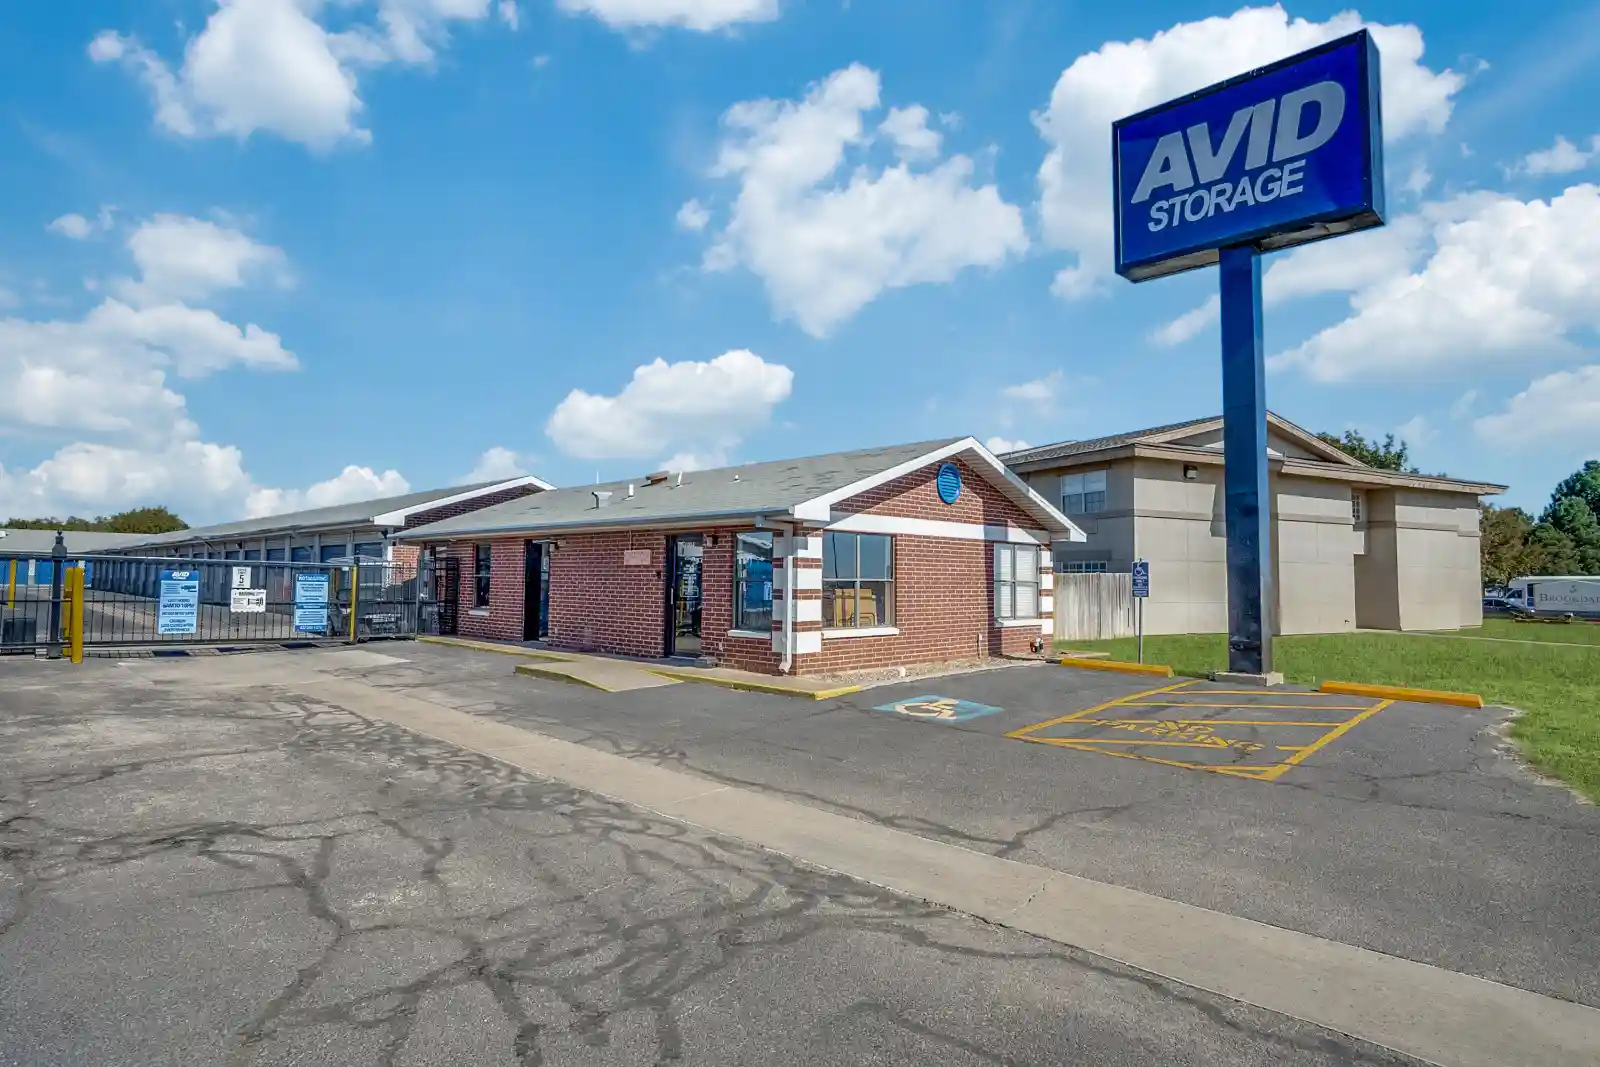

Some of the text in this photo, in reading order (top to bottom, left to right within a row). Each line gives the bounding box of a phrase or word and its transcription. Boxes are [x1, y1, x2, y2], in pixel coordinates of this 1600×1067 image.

[1131, 80, 1346, 204] AVID
[1147, 159, 1307, 233] STORAGE
[238, 574, 245, 584] 5
